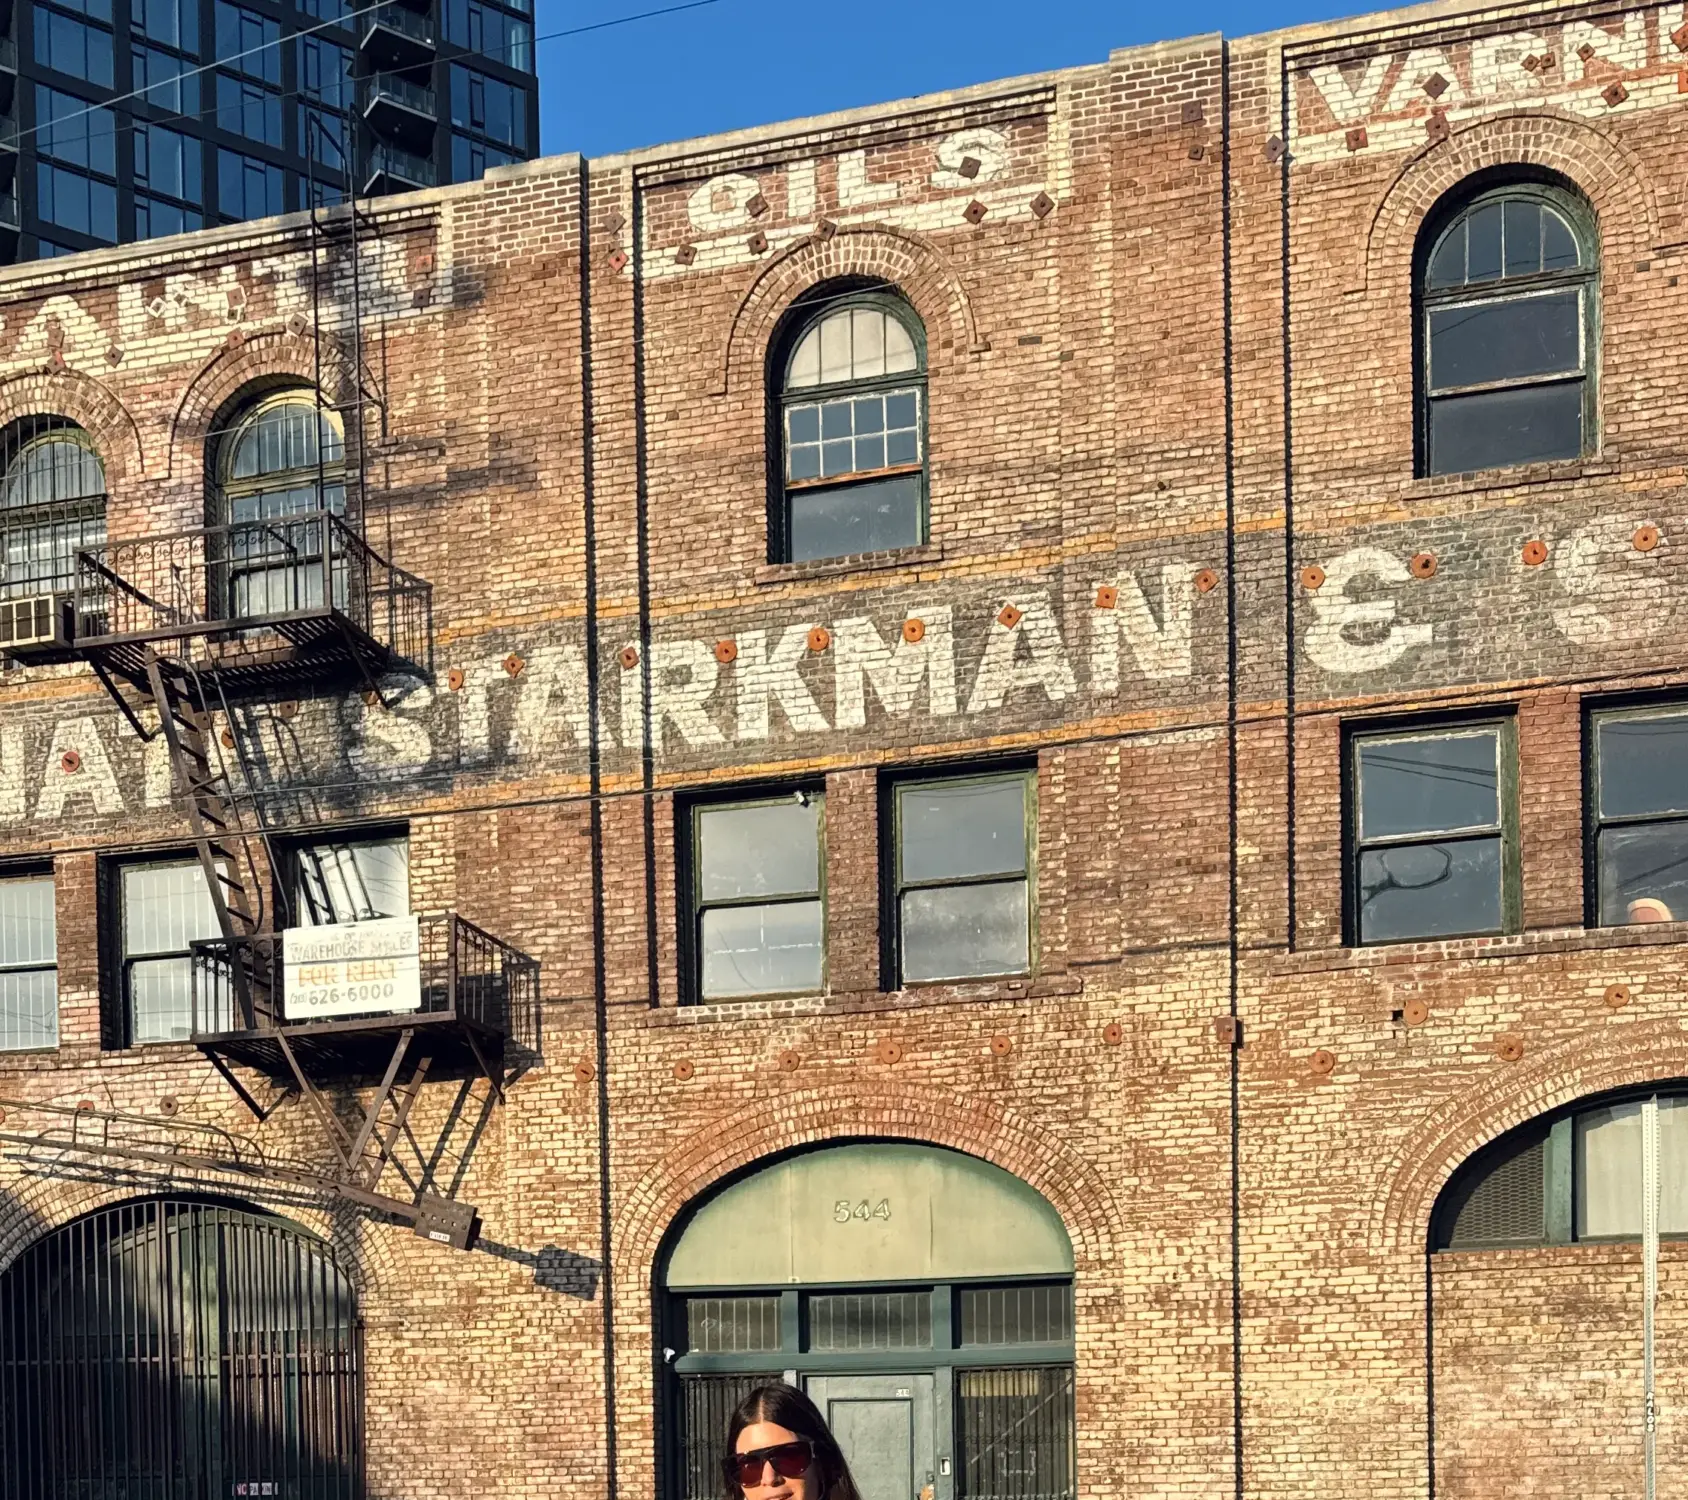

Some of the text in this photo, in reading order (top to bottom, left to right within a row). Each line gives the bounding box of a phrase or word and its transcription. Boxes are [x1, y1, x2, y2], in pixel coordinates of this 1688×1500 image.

[687, 128, 1012, 233] OILS
[0, 238, 408, 351] AINT
[347, 561, 1198, 785] STARKMAN
[298, 959, 398, 987] FOR RENT
[309, 983, 394, 1005] 626-6000
[833, 1198, 891, 1223] 544
[236, 1483, 277, 1495] NO PAKIN
